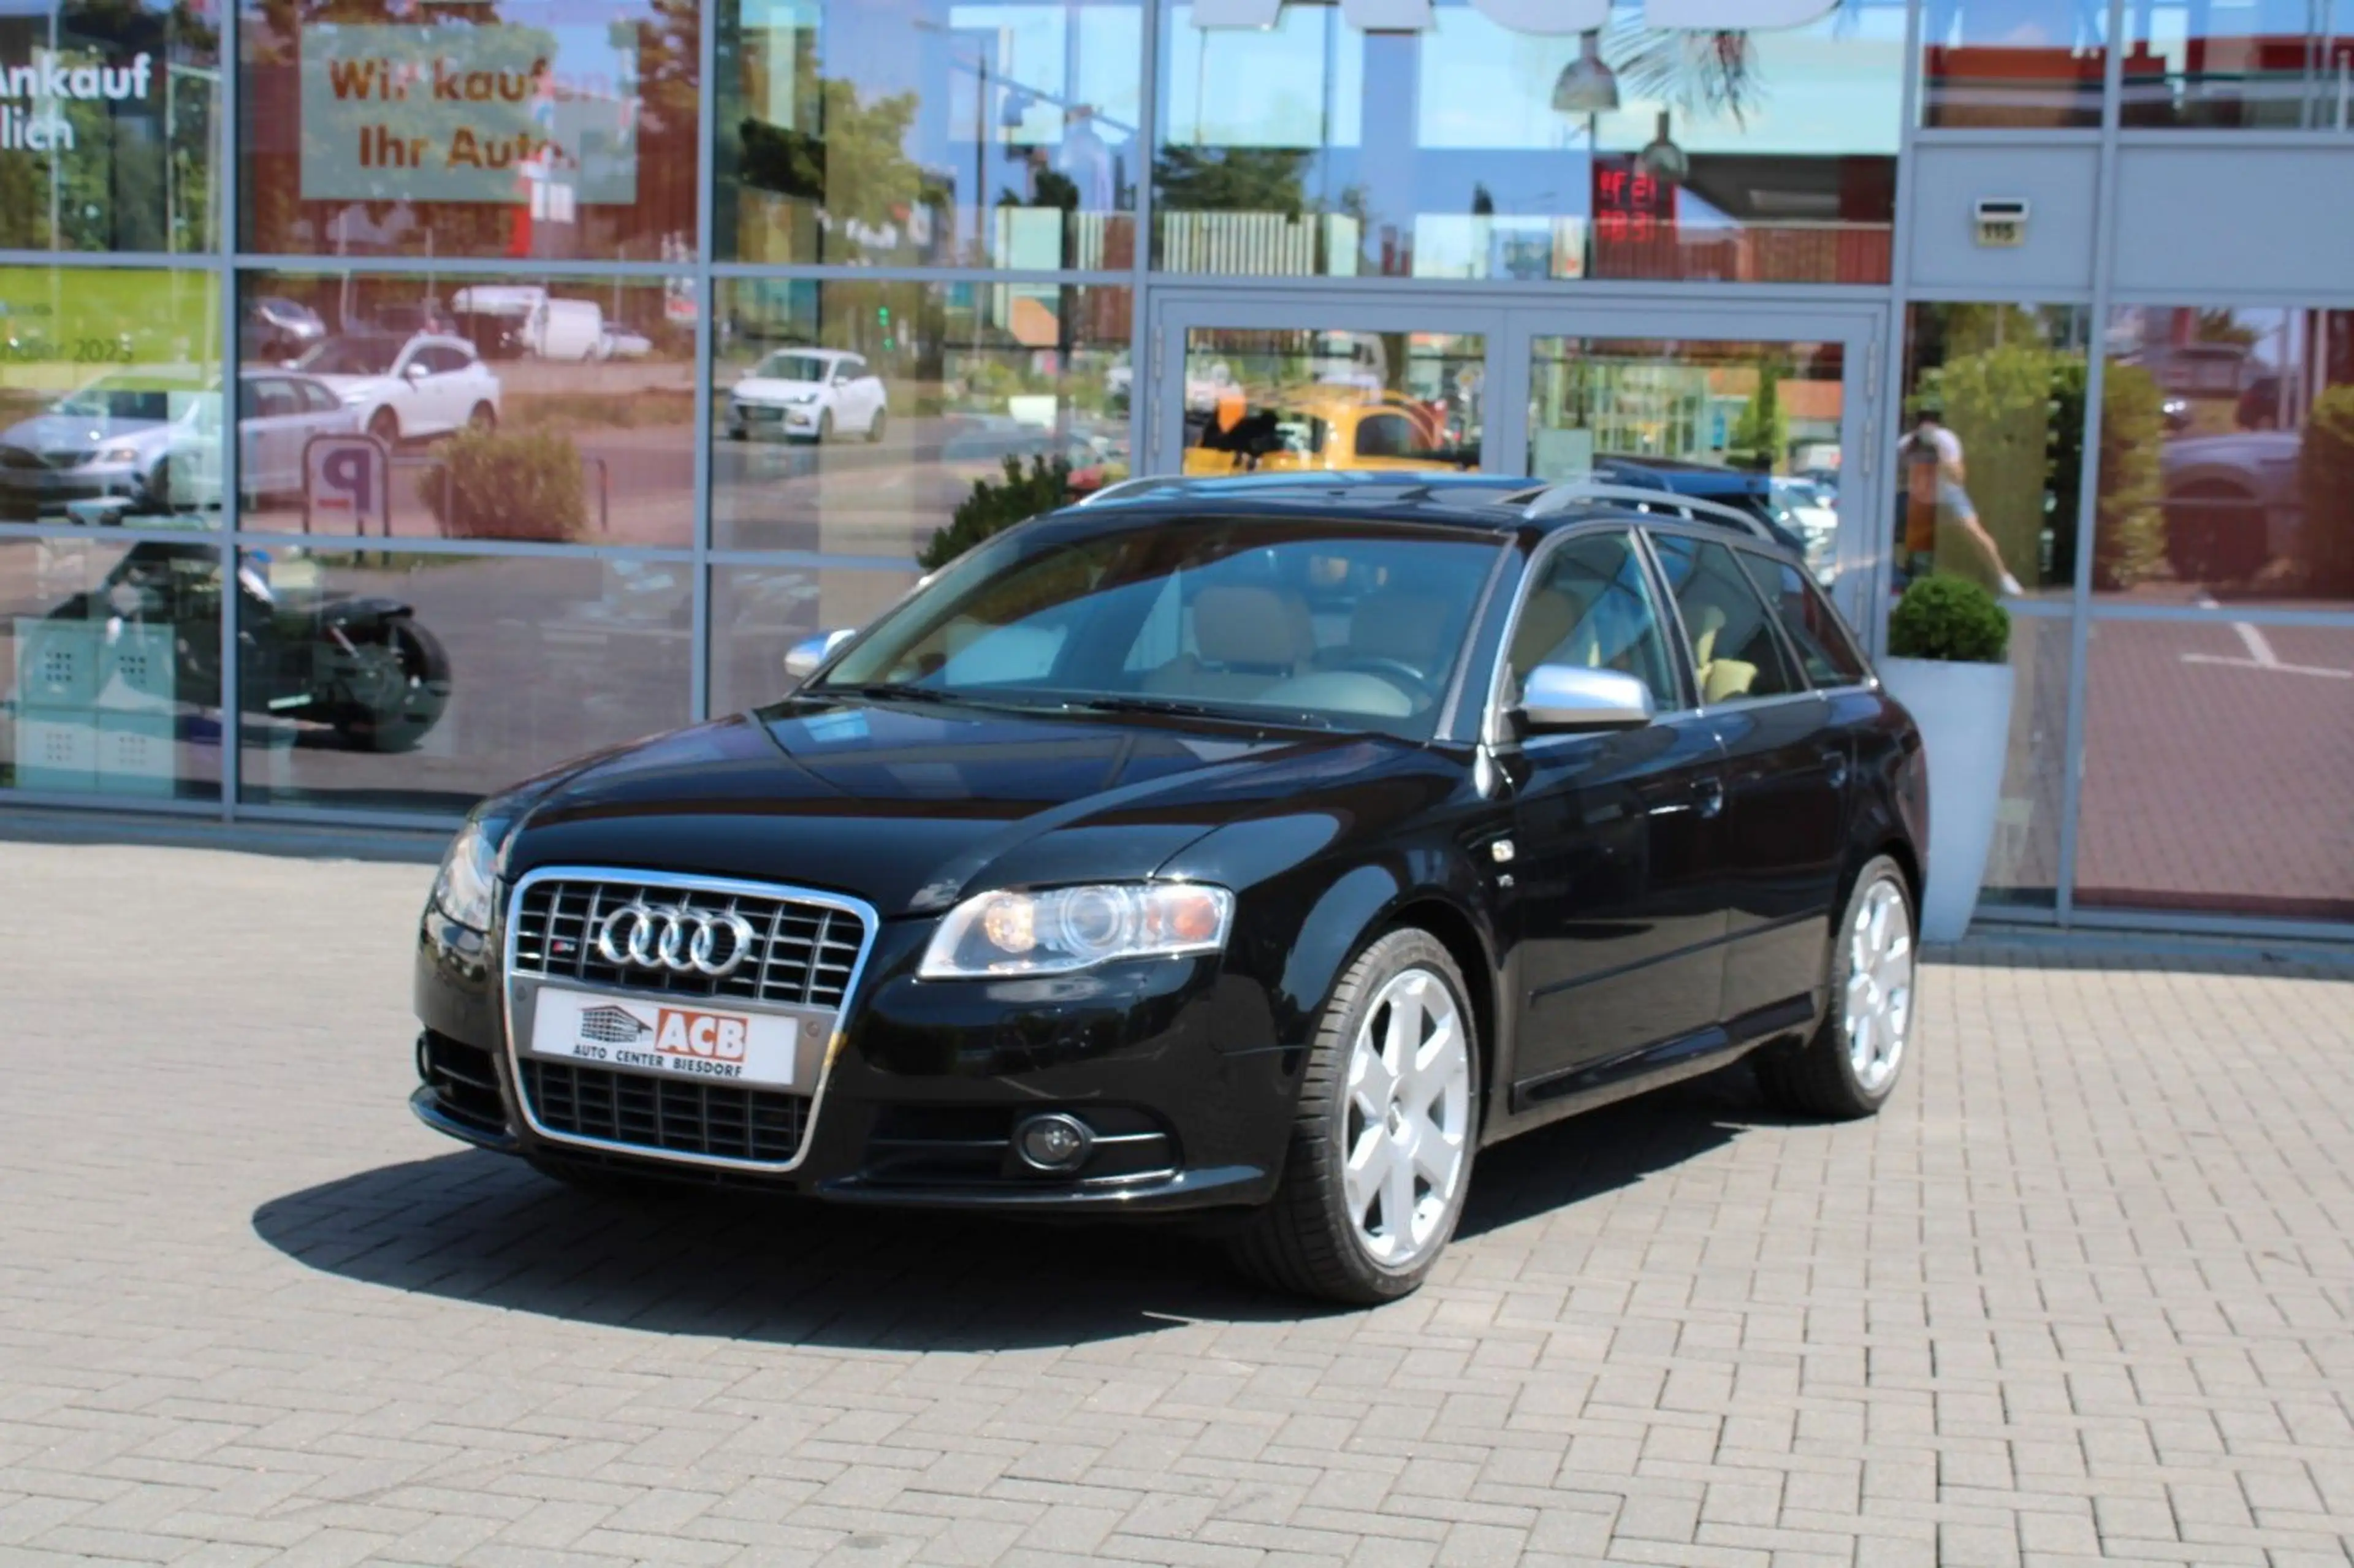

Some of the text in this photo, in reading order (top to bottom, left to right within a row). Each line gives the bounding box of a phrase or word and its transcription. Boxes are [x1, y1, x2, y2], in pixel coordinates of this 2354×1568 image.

[359, 126, 428, 168] Ihr
[657, 1011, 745, 1060] ACB
[573, 1045, 743, 1078] AUTO CENTER BIESDORF
